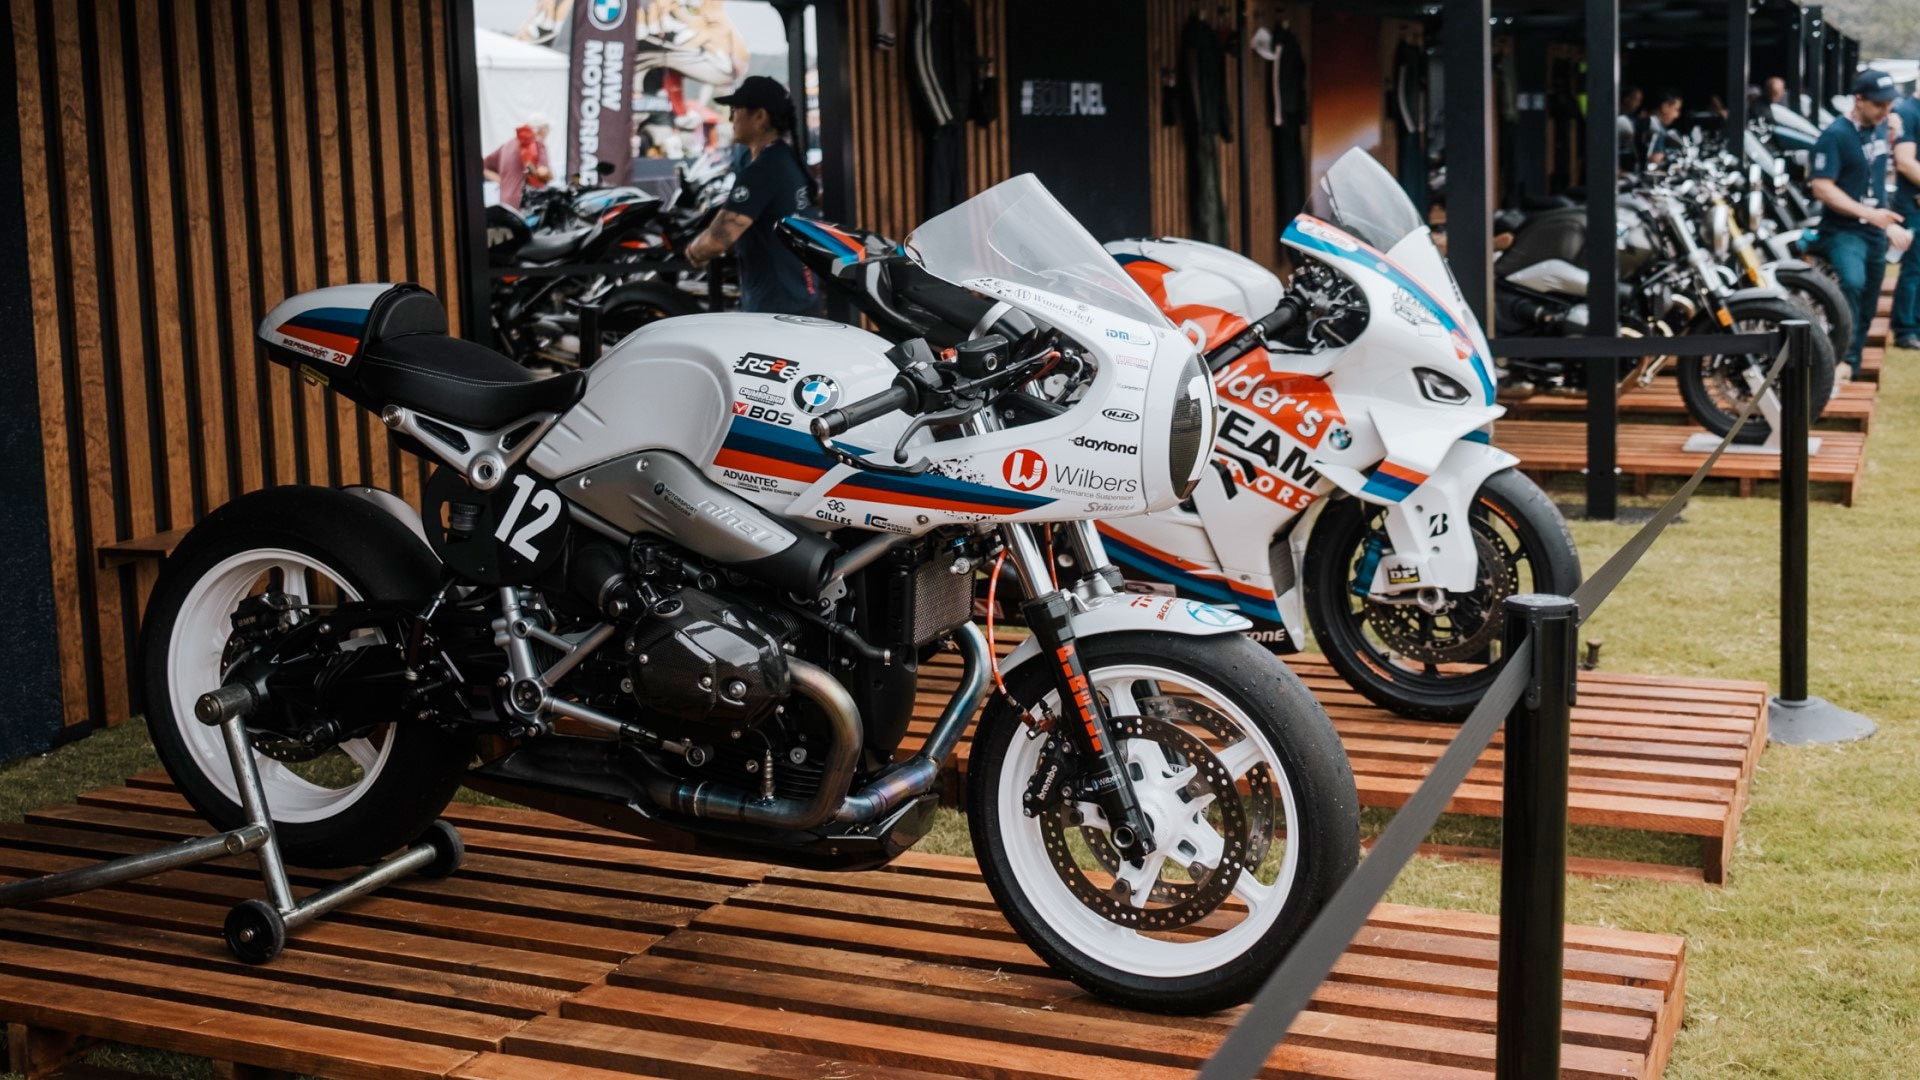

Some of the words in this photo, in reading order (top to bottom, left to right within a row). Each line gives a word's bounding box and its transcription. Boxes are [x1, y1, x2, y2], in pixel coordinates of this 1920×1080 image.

[601, 41, 624, 112] BMW
[1034, 294, 1093, 325] Wunderlich
[332, 352, 347, 365] 2D
[749, 405, 795, 426] BOS
[1107, 410, 1134, 420] HJC
[1073, 436, 1138, 455] daytona
[723, 469, 778, 489] ADVANTEC
[738, 481, 760, 490] ORIGINAL
[1055, 464, 1138, 493] Wilbers
[664, 487, 698, 514] MOTORSPORT
[1050, 485, 1095, 499] Performance
[1095, 492, 1134, 501] Suspension
[494, 474, 562, 563] 12
[816, 509, 852, 526] GILLES
[1036, 764, 1058, 801] brembo
